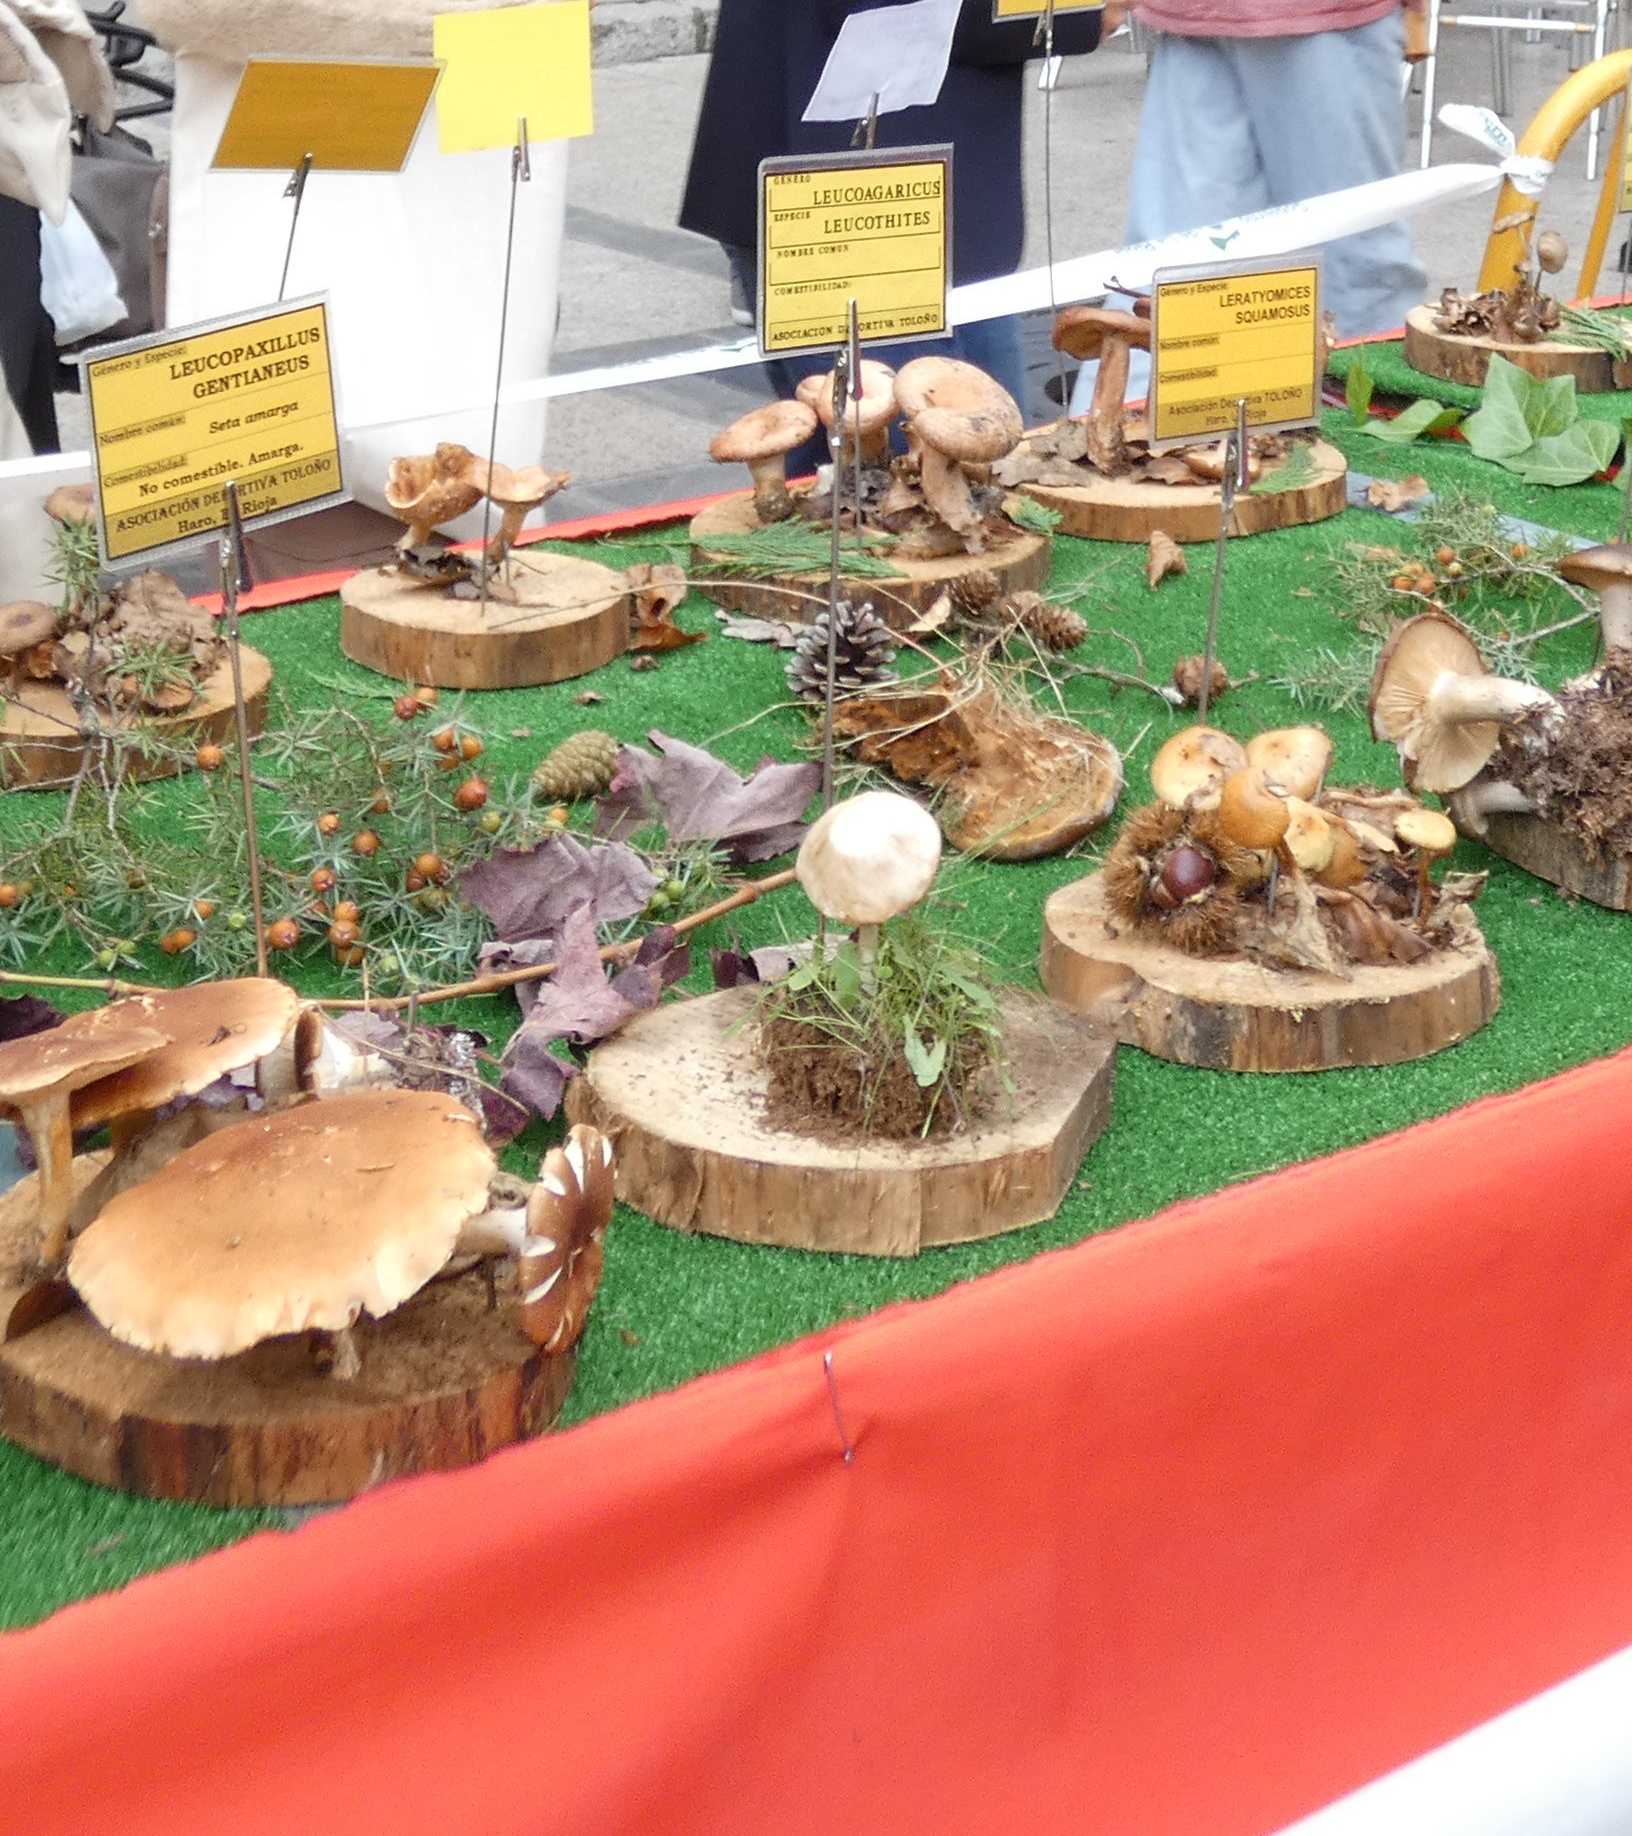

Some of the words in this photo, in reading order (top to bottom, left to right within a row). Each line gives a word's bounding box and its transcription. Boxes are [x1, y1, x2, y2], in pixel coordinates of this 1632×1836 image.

[813, 181, 941, 206] LEUCOAGARICUS
[773, 211, 811, 222] ESPECIE
[823, 211, 931, 234] LEUCOTHITES
[776, 247, 814, 259] NOMBRE
[1219, 285, 1312, 308] LERATYOMICES
[899, 313, 939, 328] TOLOÑO
[1235, 304, 1311, 325] SQUAMOSUS
[169, 327, 321, 381] LEUCOPAXILLUS
[1160, 338, 1190, 351] Nombre
[92, 359, 132, 378] Género
[192, 355, 310, 399] GENTIANEUS
[1264, 387, 1303, 402] TOLOÑO
[208, 418, 241, 435] Seta
[245, 400, 299, 426] amarga
[99, 427, 143, 446] Nombre
[138, 482, 159, 498] No
[163, 460, 245, 490] comestible.
[248, 441, 305, 466] Amarga.
[117, 494, 201, 533] ASOCIACIÓN
[281, 458, 332, 484] TOLOÑO
[241, 495, 278, 516] Rioja
